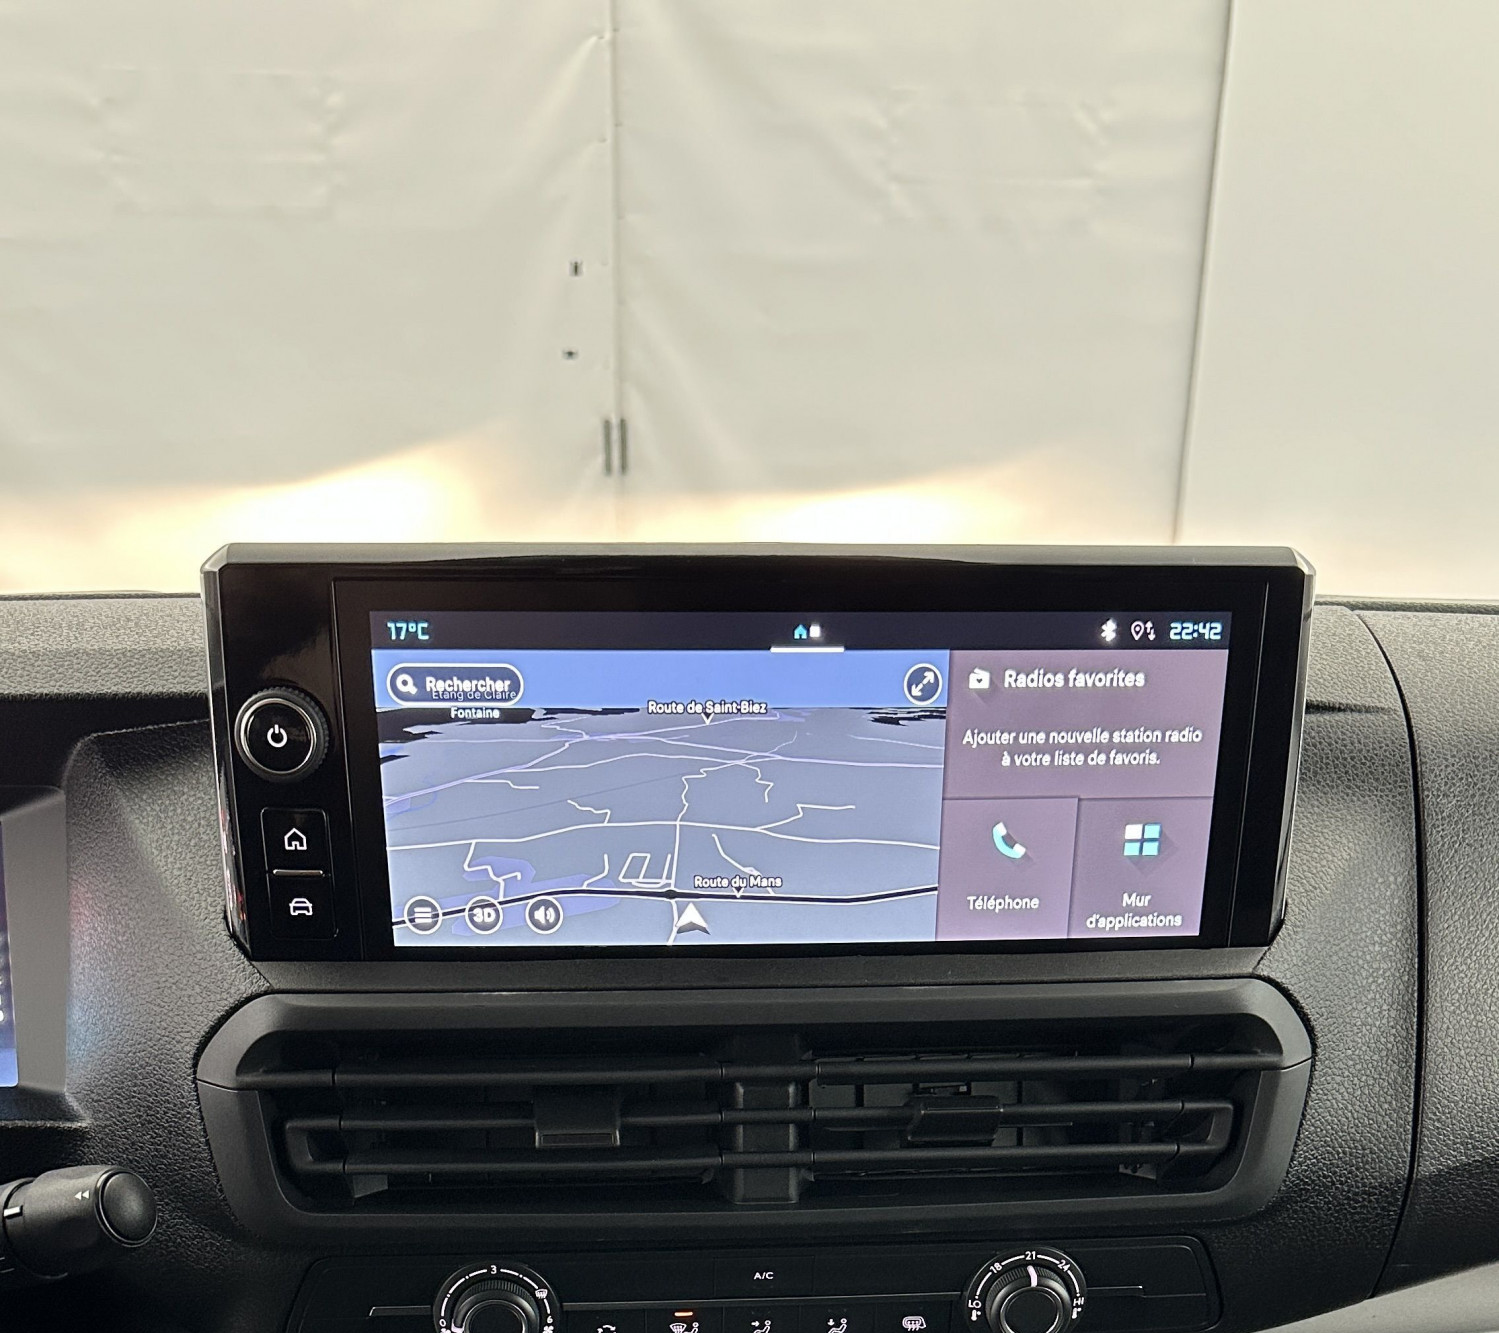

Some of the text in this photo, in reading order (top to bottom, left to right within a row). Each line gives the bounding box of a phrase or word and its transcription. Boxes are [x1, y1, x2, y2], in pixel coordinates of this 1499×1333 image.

[386, 621, 430, 641] 17°C
[1169, 621, 1223, 641] 22:42
[425, 676, 511, 692] Rechercher
[1003, 667, 1145, 689] Radios favorites
[467, 690, 481, 700] de
[450, 706, 500, 719] Fontaine
[648, 700, 767, 714] Route de Saint-Biez
[962, 726, 1203, 748] Ajouter une nouvelle station radio
[1001, 748, 1161, 766] à votre liste de favoris.
[694, 875, 782, 888] Route du Mans
[967, 895, 1040, 912] Téléphone
[1122, 892, 1152, 908] Mur
[472, 907, 496, 923] 3D
[1086, 912, 1183, 931] d'applications
[1025, 1251, 1036, 1260] 21
[490, 1265, 497, 1275] 3
[989, 1262, 1003, 1273] 18
[1057, 1260, 1071, 1272] 24
[753, 1271, 774, 1280] A/C
[968, 1299, 982, 1308] LO
[1073, 1297, 1085, 1307] HI
[547, 1315, 553, 1324] 6
